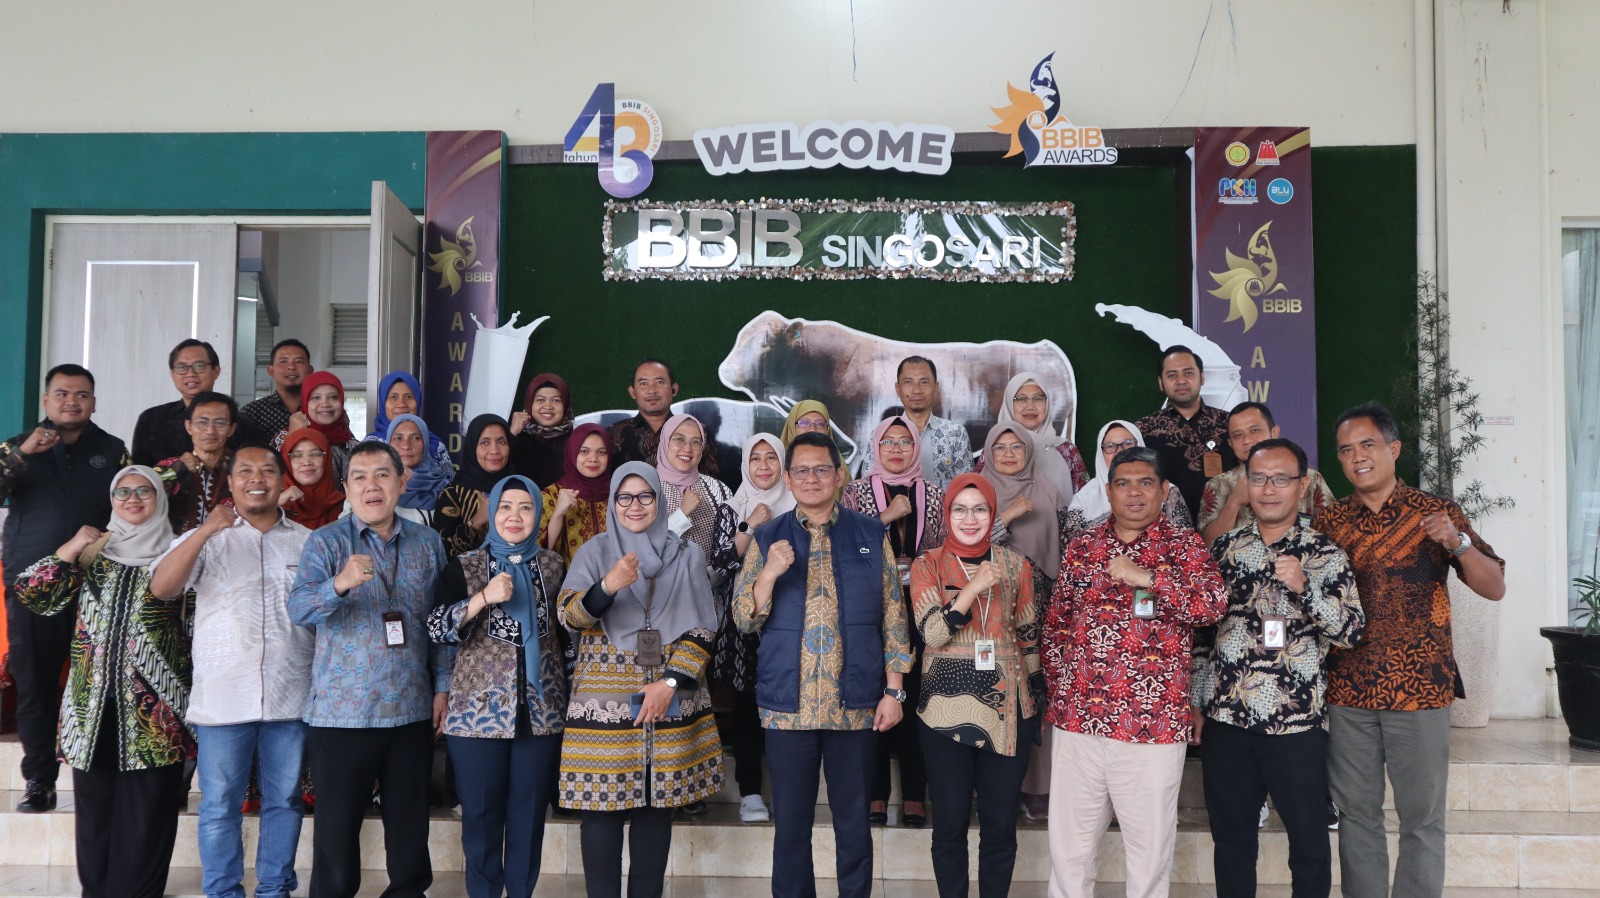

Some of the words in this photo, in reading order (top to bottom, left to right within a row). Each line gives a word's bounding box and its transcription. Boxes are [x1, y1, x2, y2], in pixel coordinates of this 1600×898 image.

[643, 107, 660, 152] SINGOSARI
[1042, 127, 1102, 149] BBIB
[702, 128, 946, 167] WELCOME
[1043, 149, 1117, 164] AWARDS
[564, 152, 598, 162] tahun
[1219, 178, 1256, 196] PKH
[1272, 186, 1290, 194] BLU
[638, 209, 803, 268] BBIB
[821, 235, 1041, 268] SINGOSARI
[465, 272, 493, 283] BBIB
[1263, 299, 1302, 313] BBIB
[448, 311, 467, 471] AWARD
